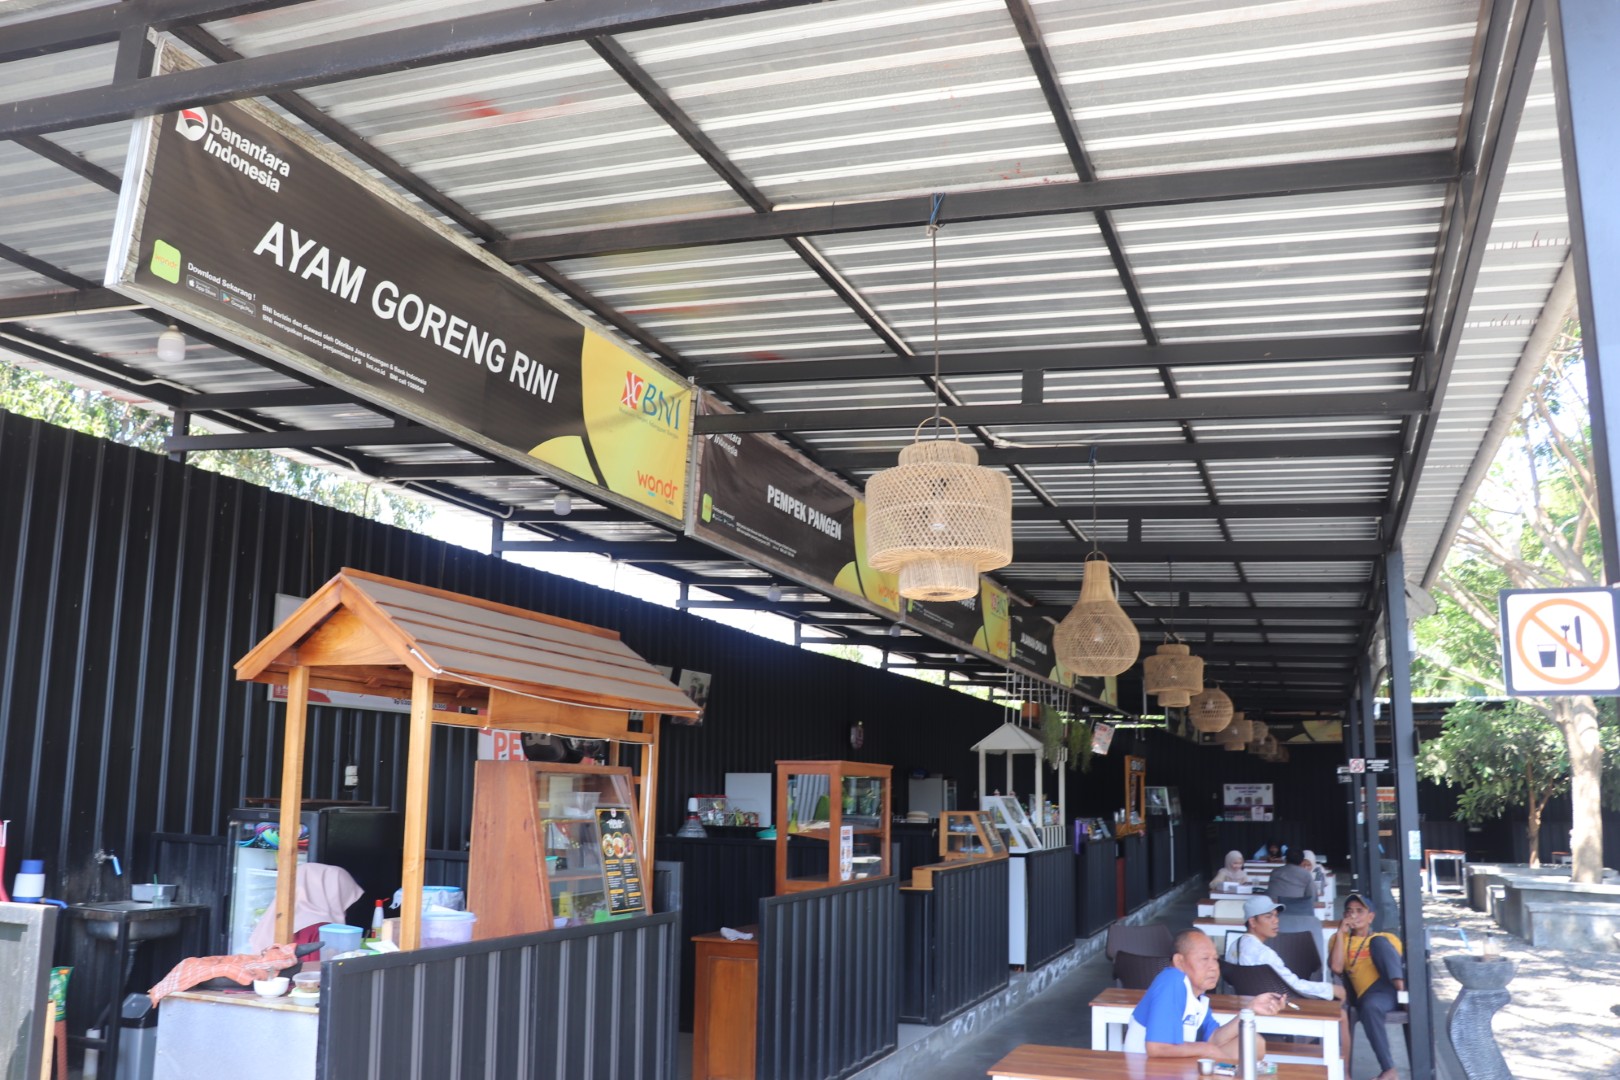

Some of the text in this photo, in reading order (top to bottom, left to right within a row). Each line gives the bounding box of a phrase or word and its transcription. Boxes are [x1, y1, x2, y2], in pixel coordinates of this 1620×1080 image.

[203, 133, 281, 193] Indonesia
[210, 113, 291, 178] Danantara
[155, 254, 178, 270] wondr
[187, 262, 221, 285] Download
[221, 279, 253, 302] Sekarang
[253, 221, 560, 404] AYAM GORENG RINI
[262, 304, 273, 315] BNI
[292, 318, 303, 328] dan
[334, 338, 354, 352] Otoritas
[262, 314, 273, 324] BNI
[351, 355, 362, 365] LPS
[642, 382, 682, 431] BNI
[637, 469, 678, 501] wondr
[767, 484, 807, 523] PEMPEK
[807, 506, 842, 541] PANGEN
